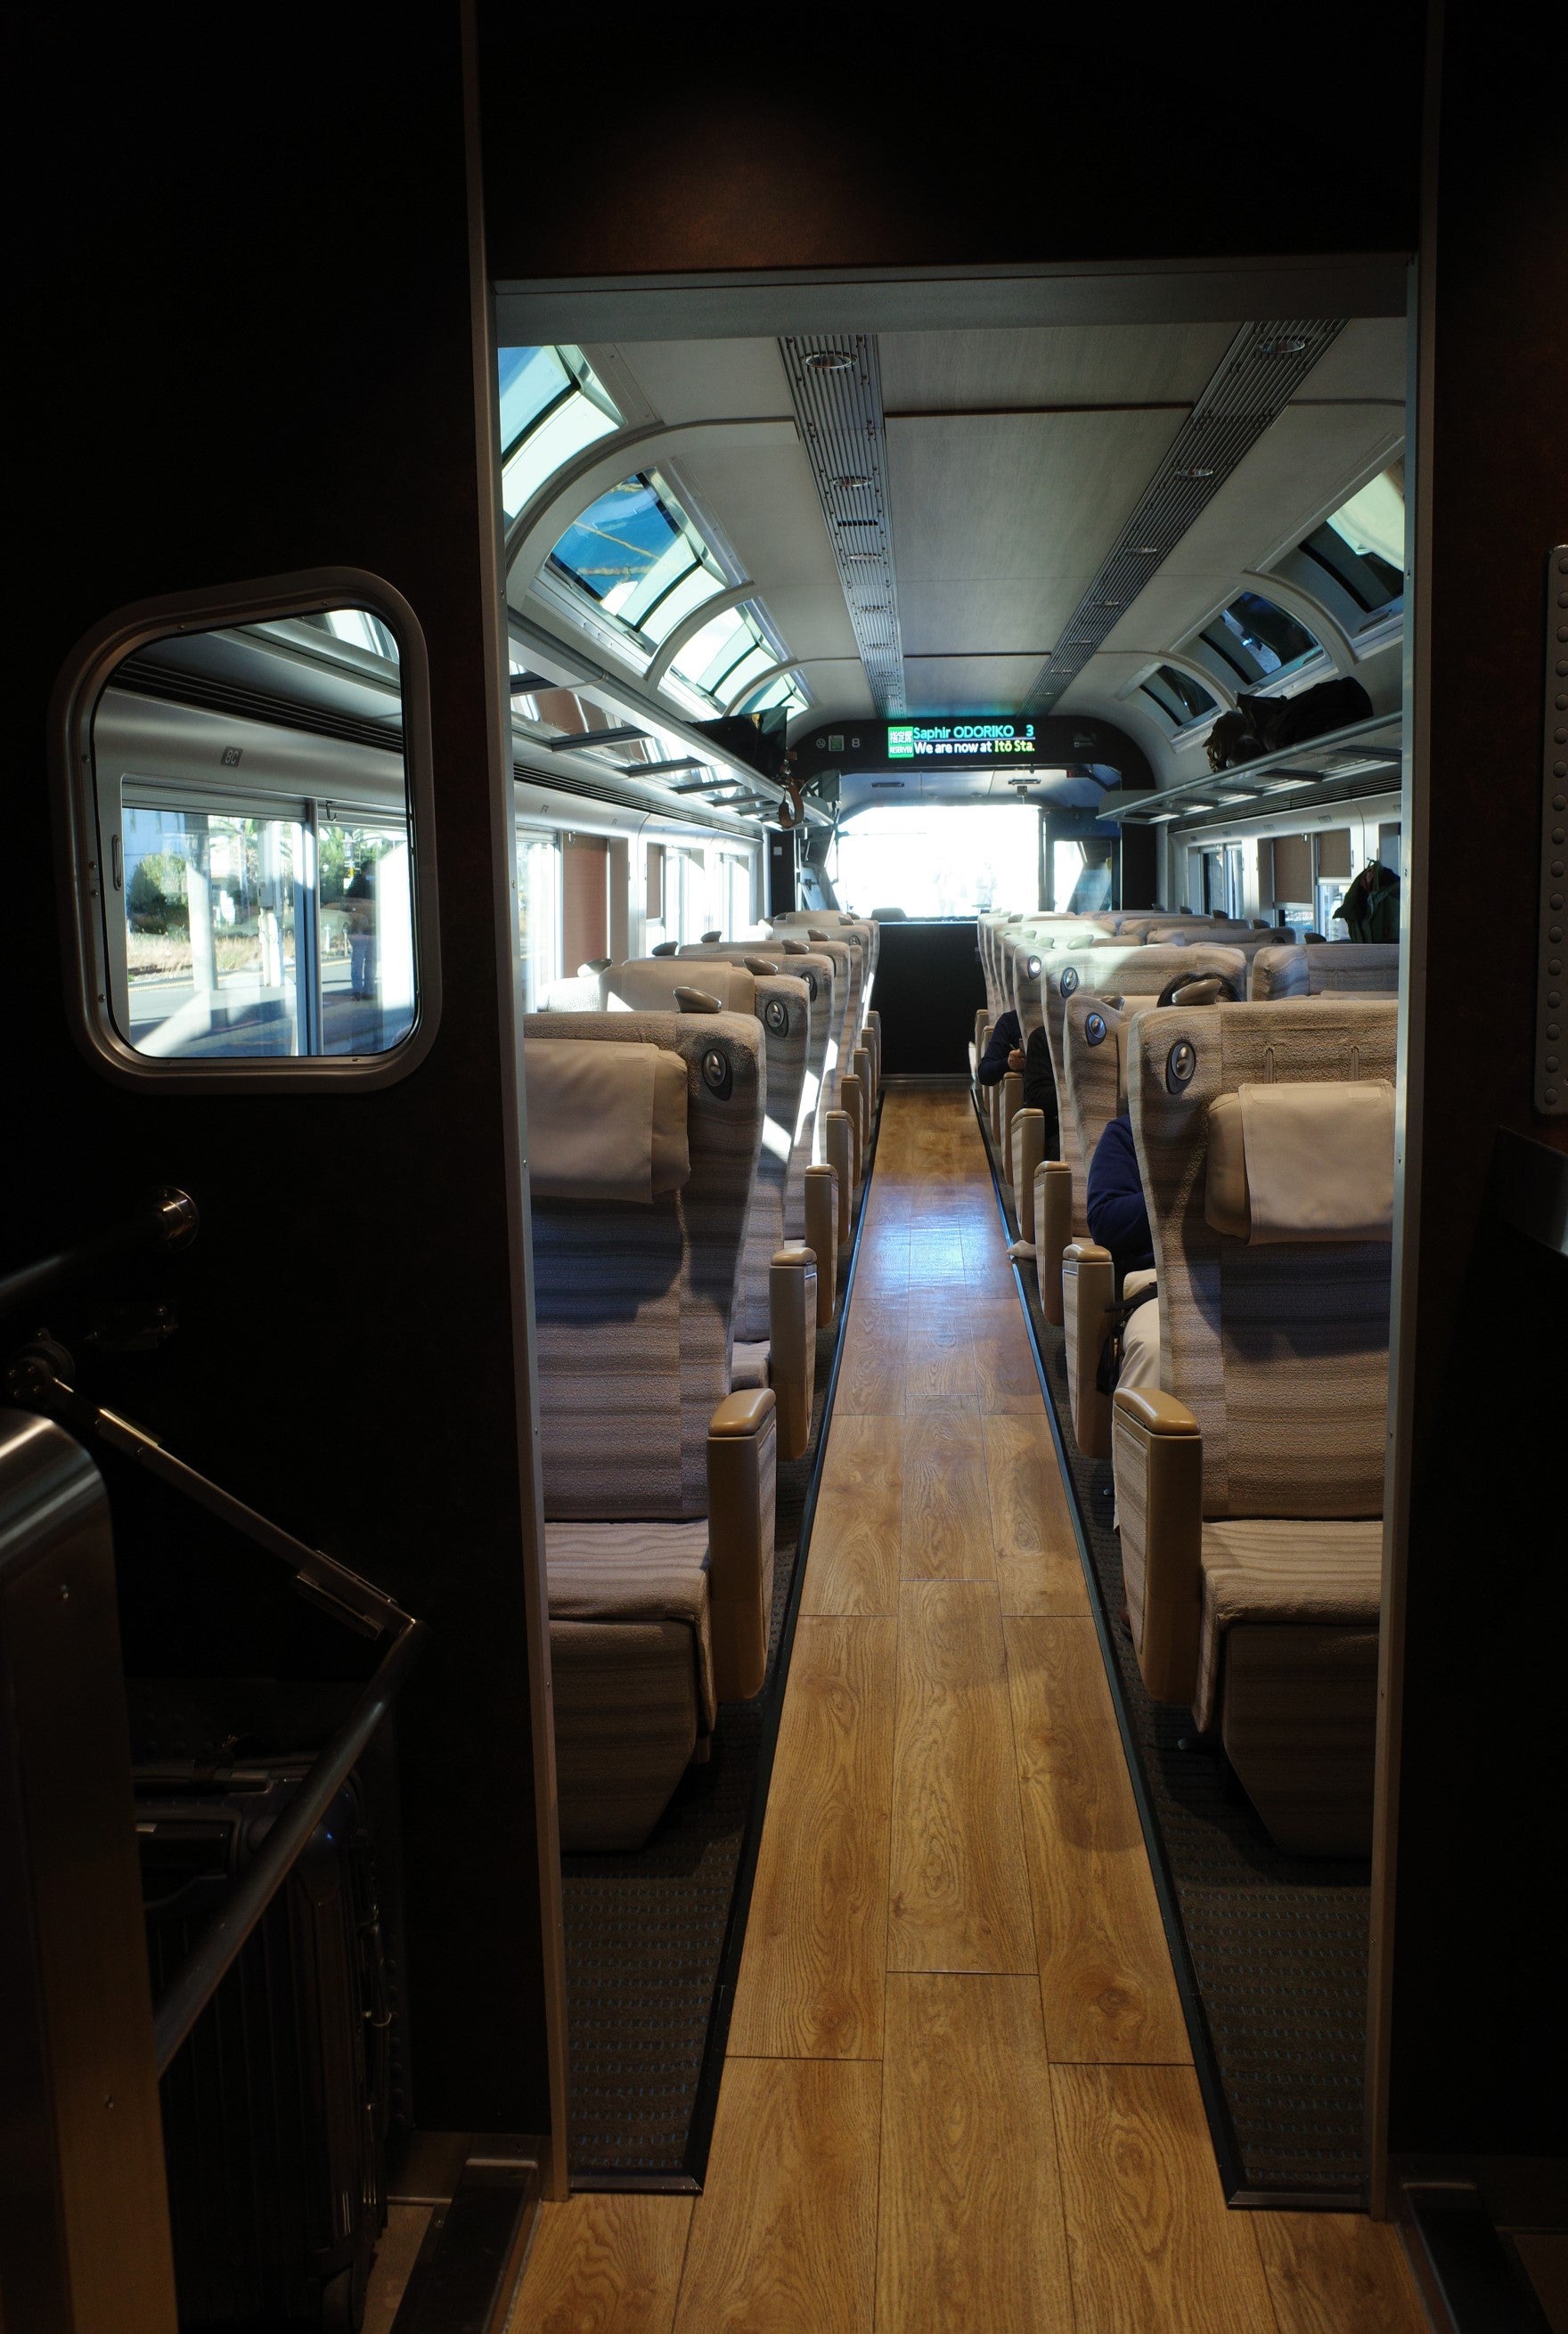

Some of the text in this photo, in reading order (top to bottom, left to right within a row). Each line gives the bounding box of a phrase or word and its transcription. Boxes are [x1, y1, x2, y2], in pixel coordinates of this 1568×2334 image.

[913, 724, 1034, 741] Saphir ODORIKO 3
[852, 738, 861, 748] 8
[914, 741, 933, 755] We
[935, 743, 952, 754] are
[954, 742, 978, 754] now
[980, 740, 992, 753] at
[1014, 739, 1035, 752] Sta.
